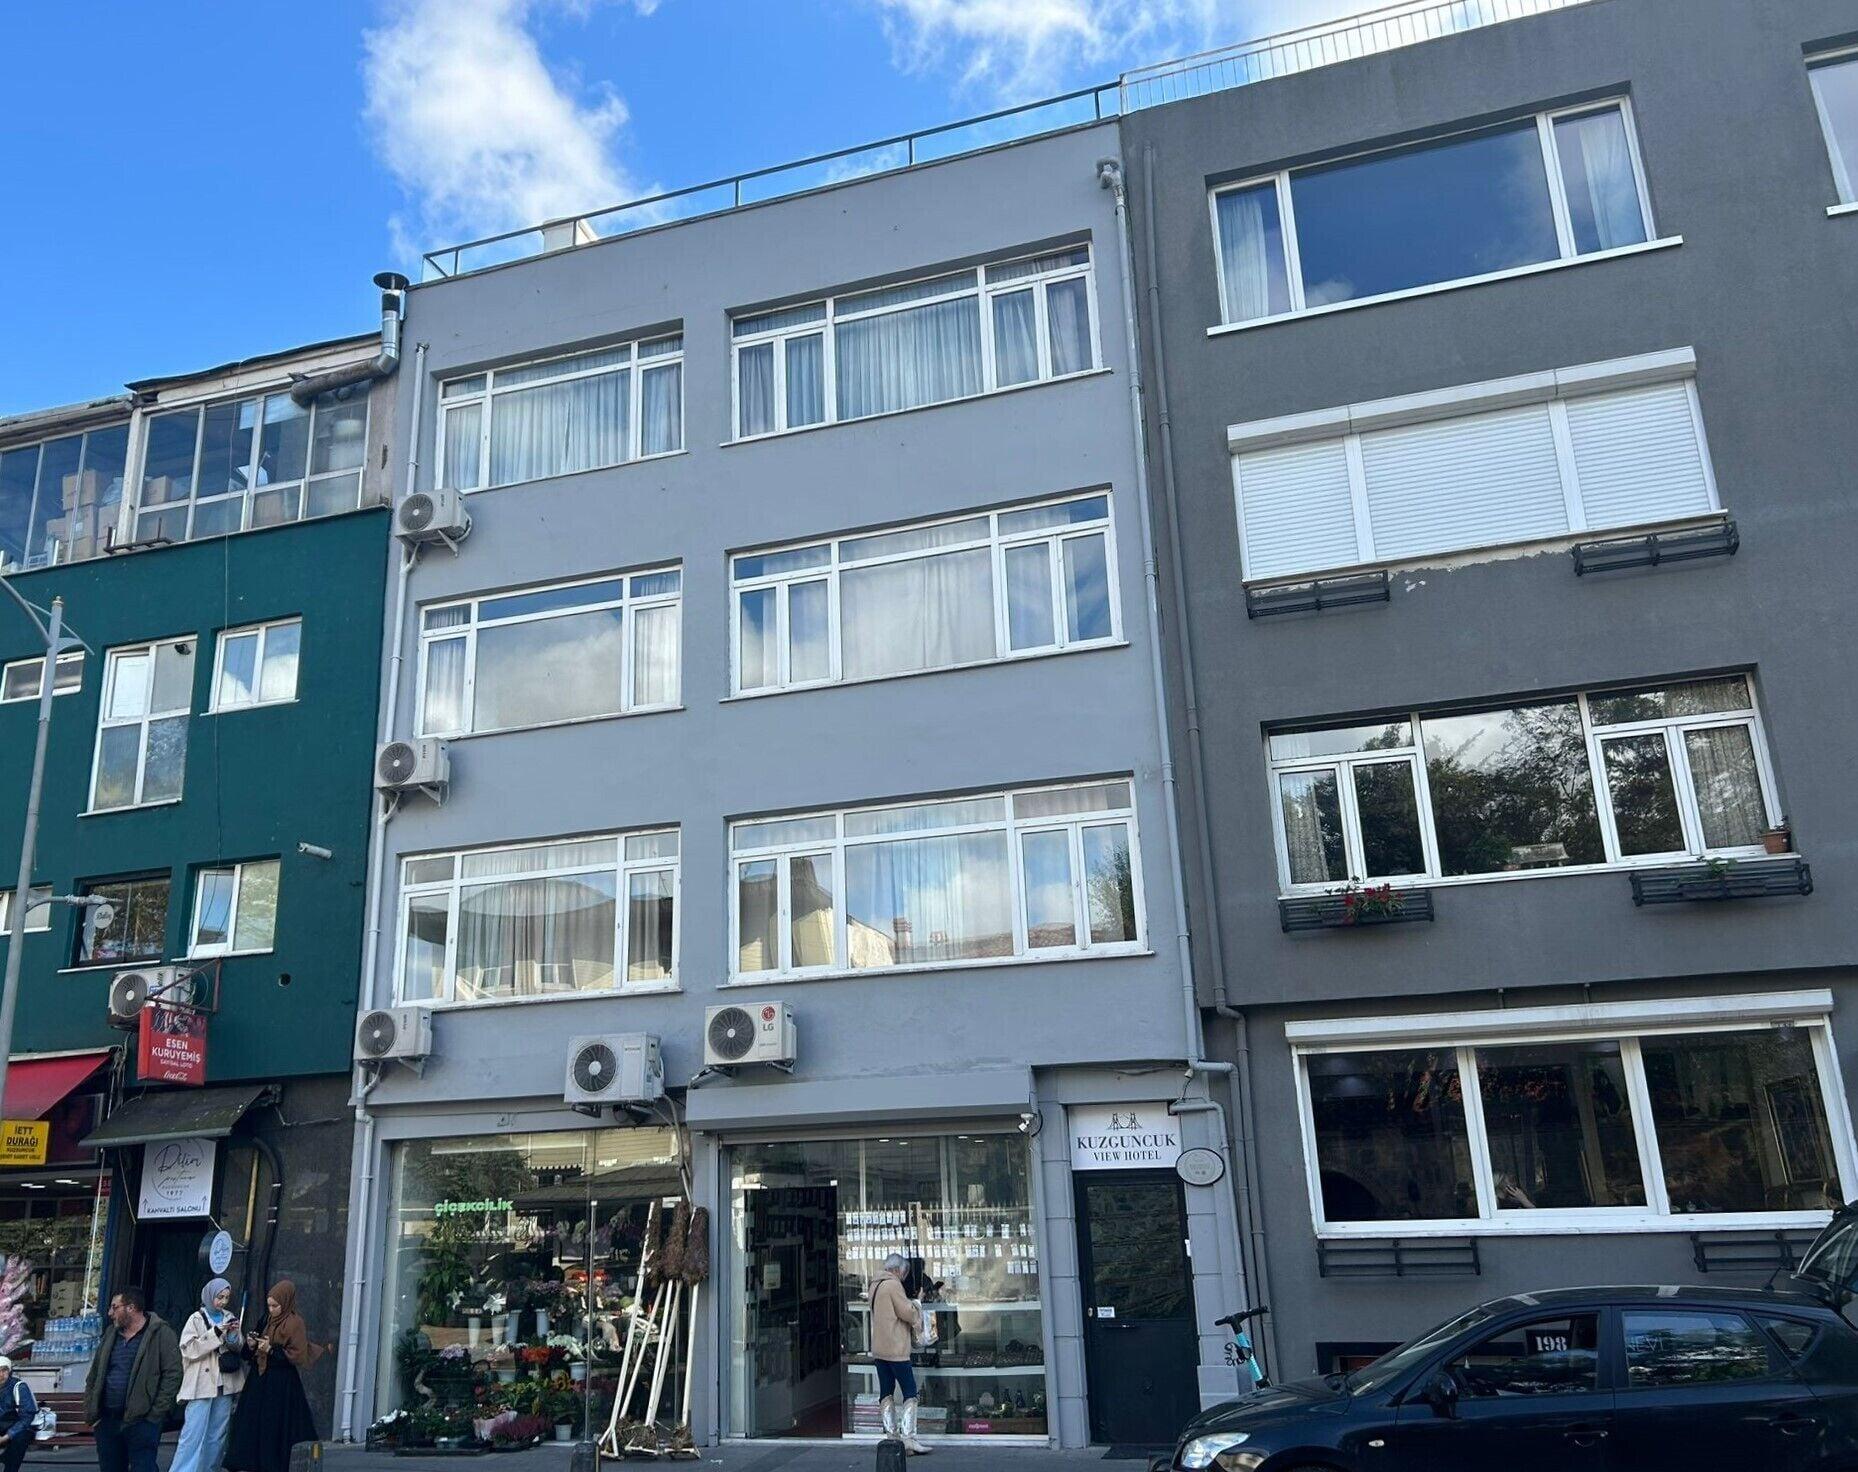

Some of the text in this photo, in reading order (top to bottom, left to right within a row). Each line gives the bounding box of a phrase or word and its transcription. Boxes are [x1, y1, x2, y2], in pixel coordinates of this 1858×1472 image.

[762, 1023, 775, 1032] LG
[165, 1038, 189, 1050] ESEN
[151, 1046, 201, 1065] KURUYEMİŞ
[1076, 1133, 1177, 1150] KUZGUNCUK
[1093, 1149, 1162, 1162] VIEW HOTEL
